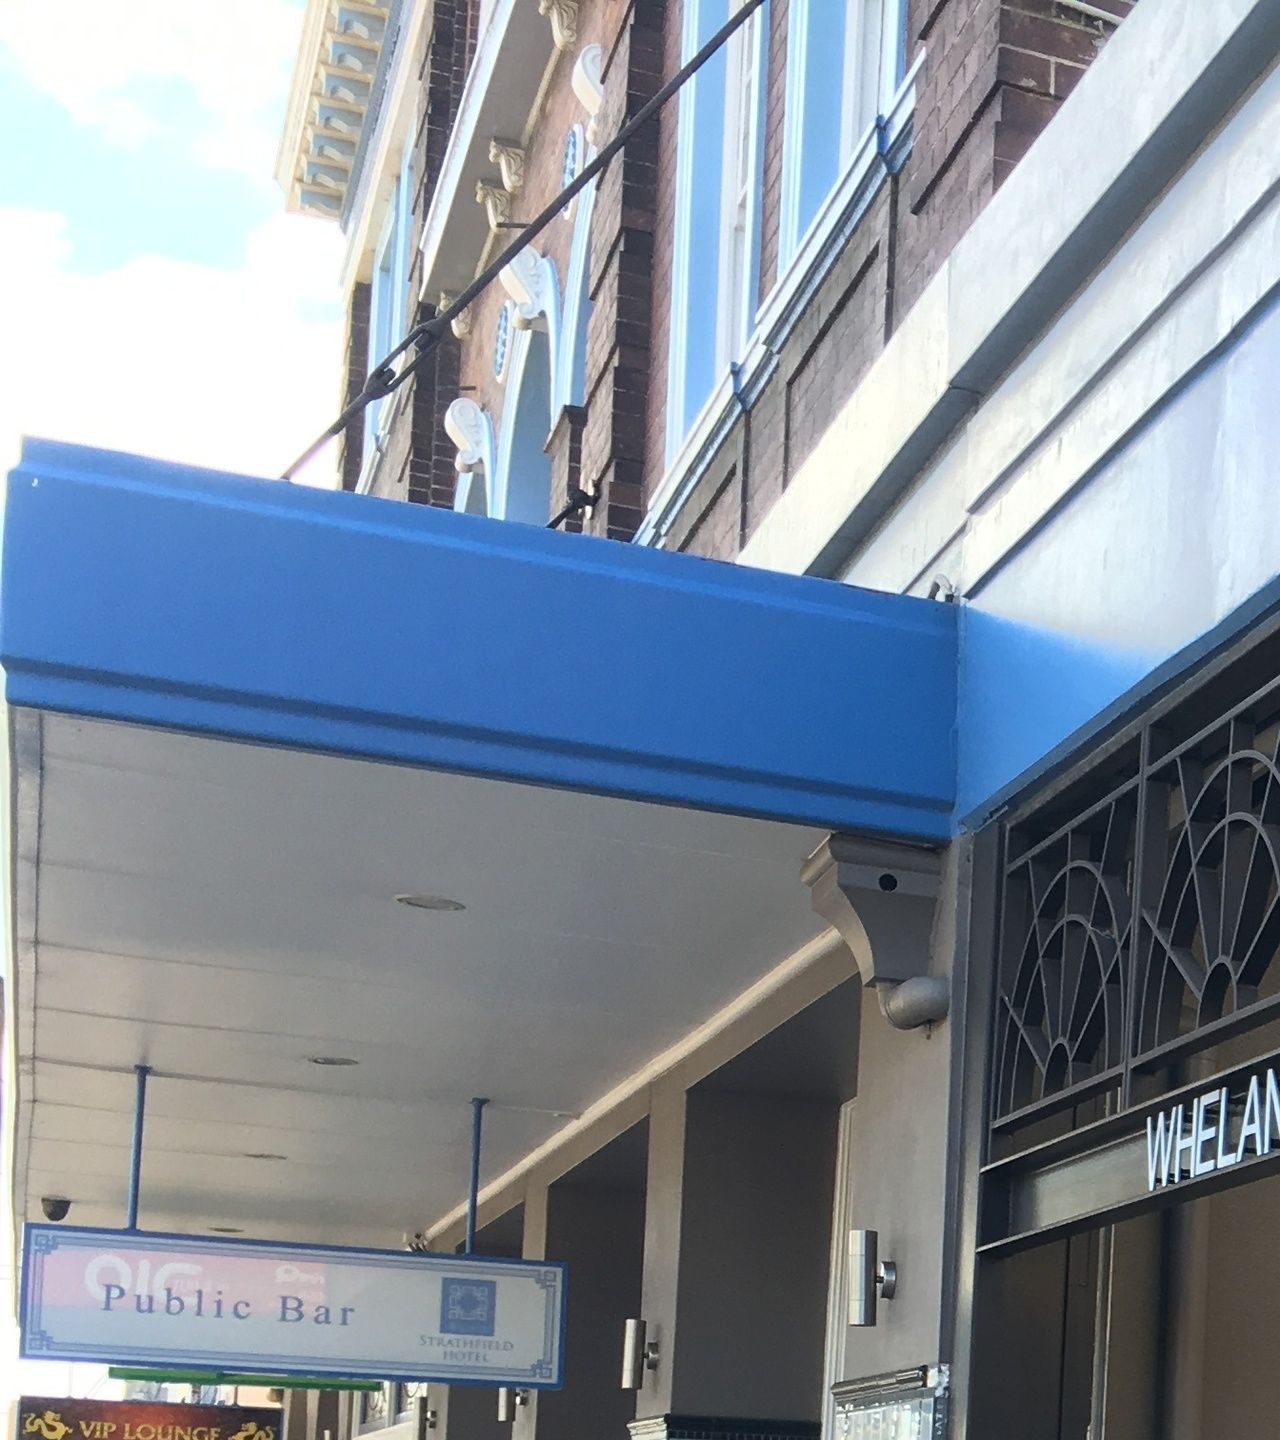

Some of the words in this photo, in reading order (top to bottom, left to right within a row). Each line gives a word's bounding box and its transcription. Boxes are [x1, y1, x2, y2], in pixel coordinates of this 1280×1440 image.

[101, 1283, 251, 1320] Public
[278, 1295, 356, 1326] Bar
[419, 1335, 514, 1351] STRATHFIELD
[443, 1350, 489, 1362] HOTEL
[79, 1420, 118, 1439] VIP
